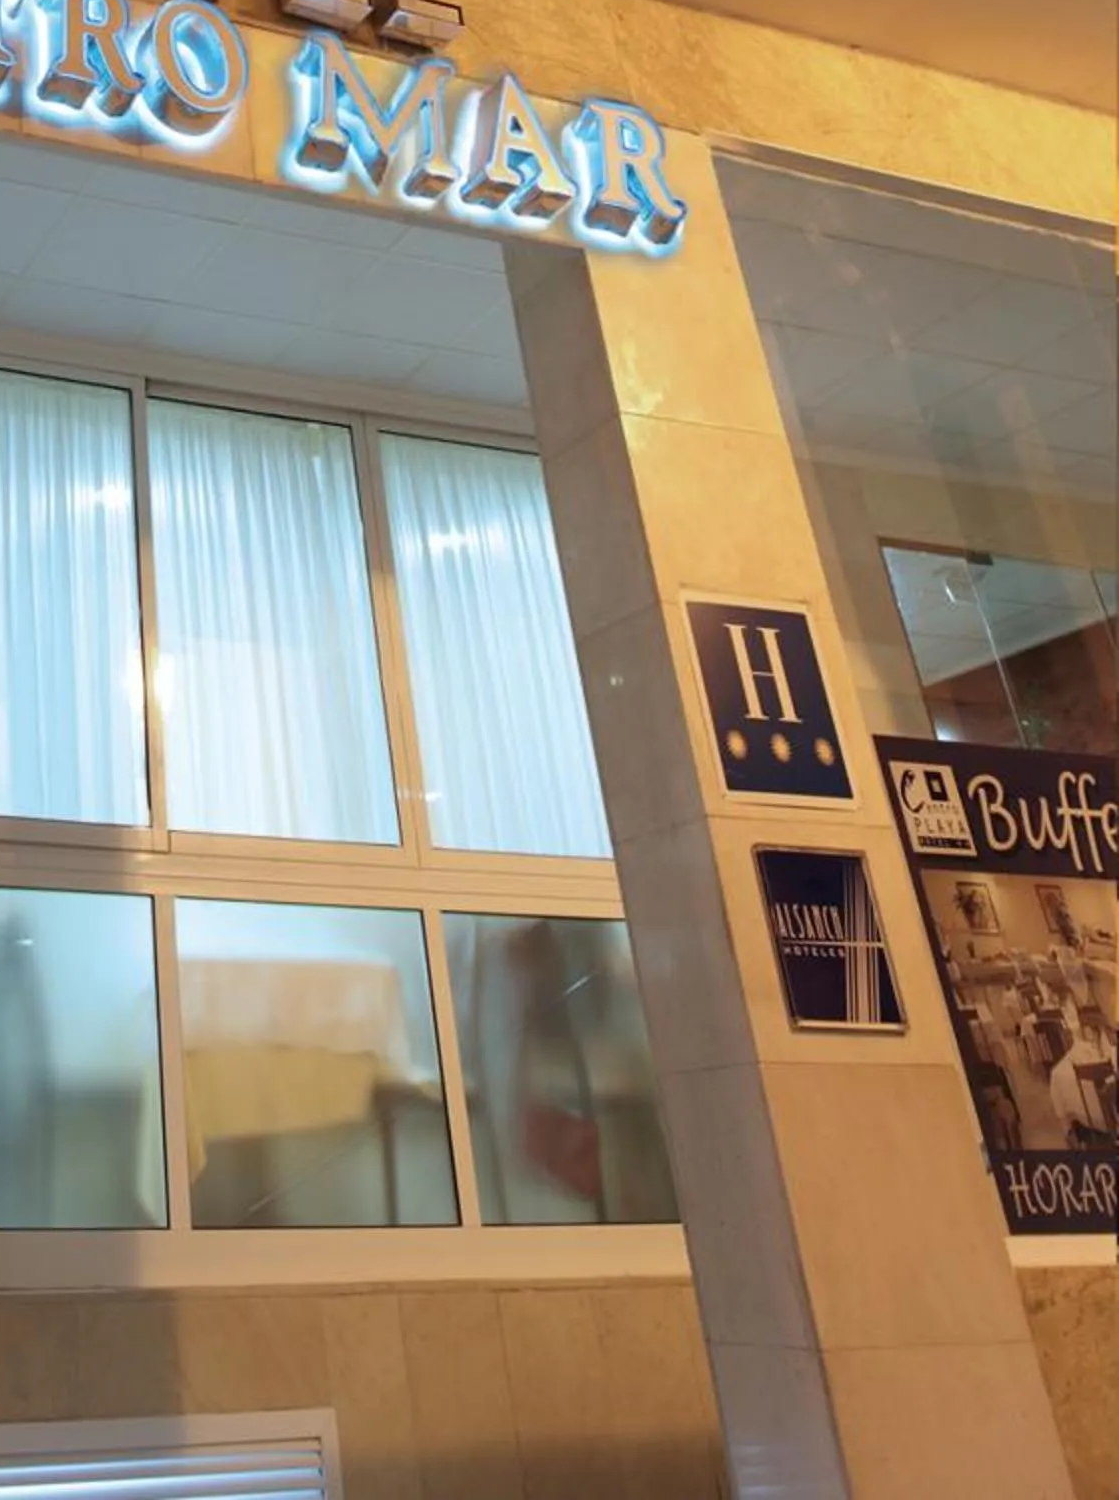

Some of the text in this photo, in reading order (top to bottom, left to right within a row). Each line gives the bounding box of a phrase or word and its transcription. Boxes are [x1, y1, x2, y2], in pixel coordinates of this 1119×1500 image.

[291, 32, 687, 238] MAR
[723, 622, 803, 725] H
[913, 817, 966, 834] PLAYA
[967, 770, 1119, 873] Buffe
[1003, 1160, 1118, 1219] HORAR
